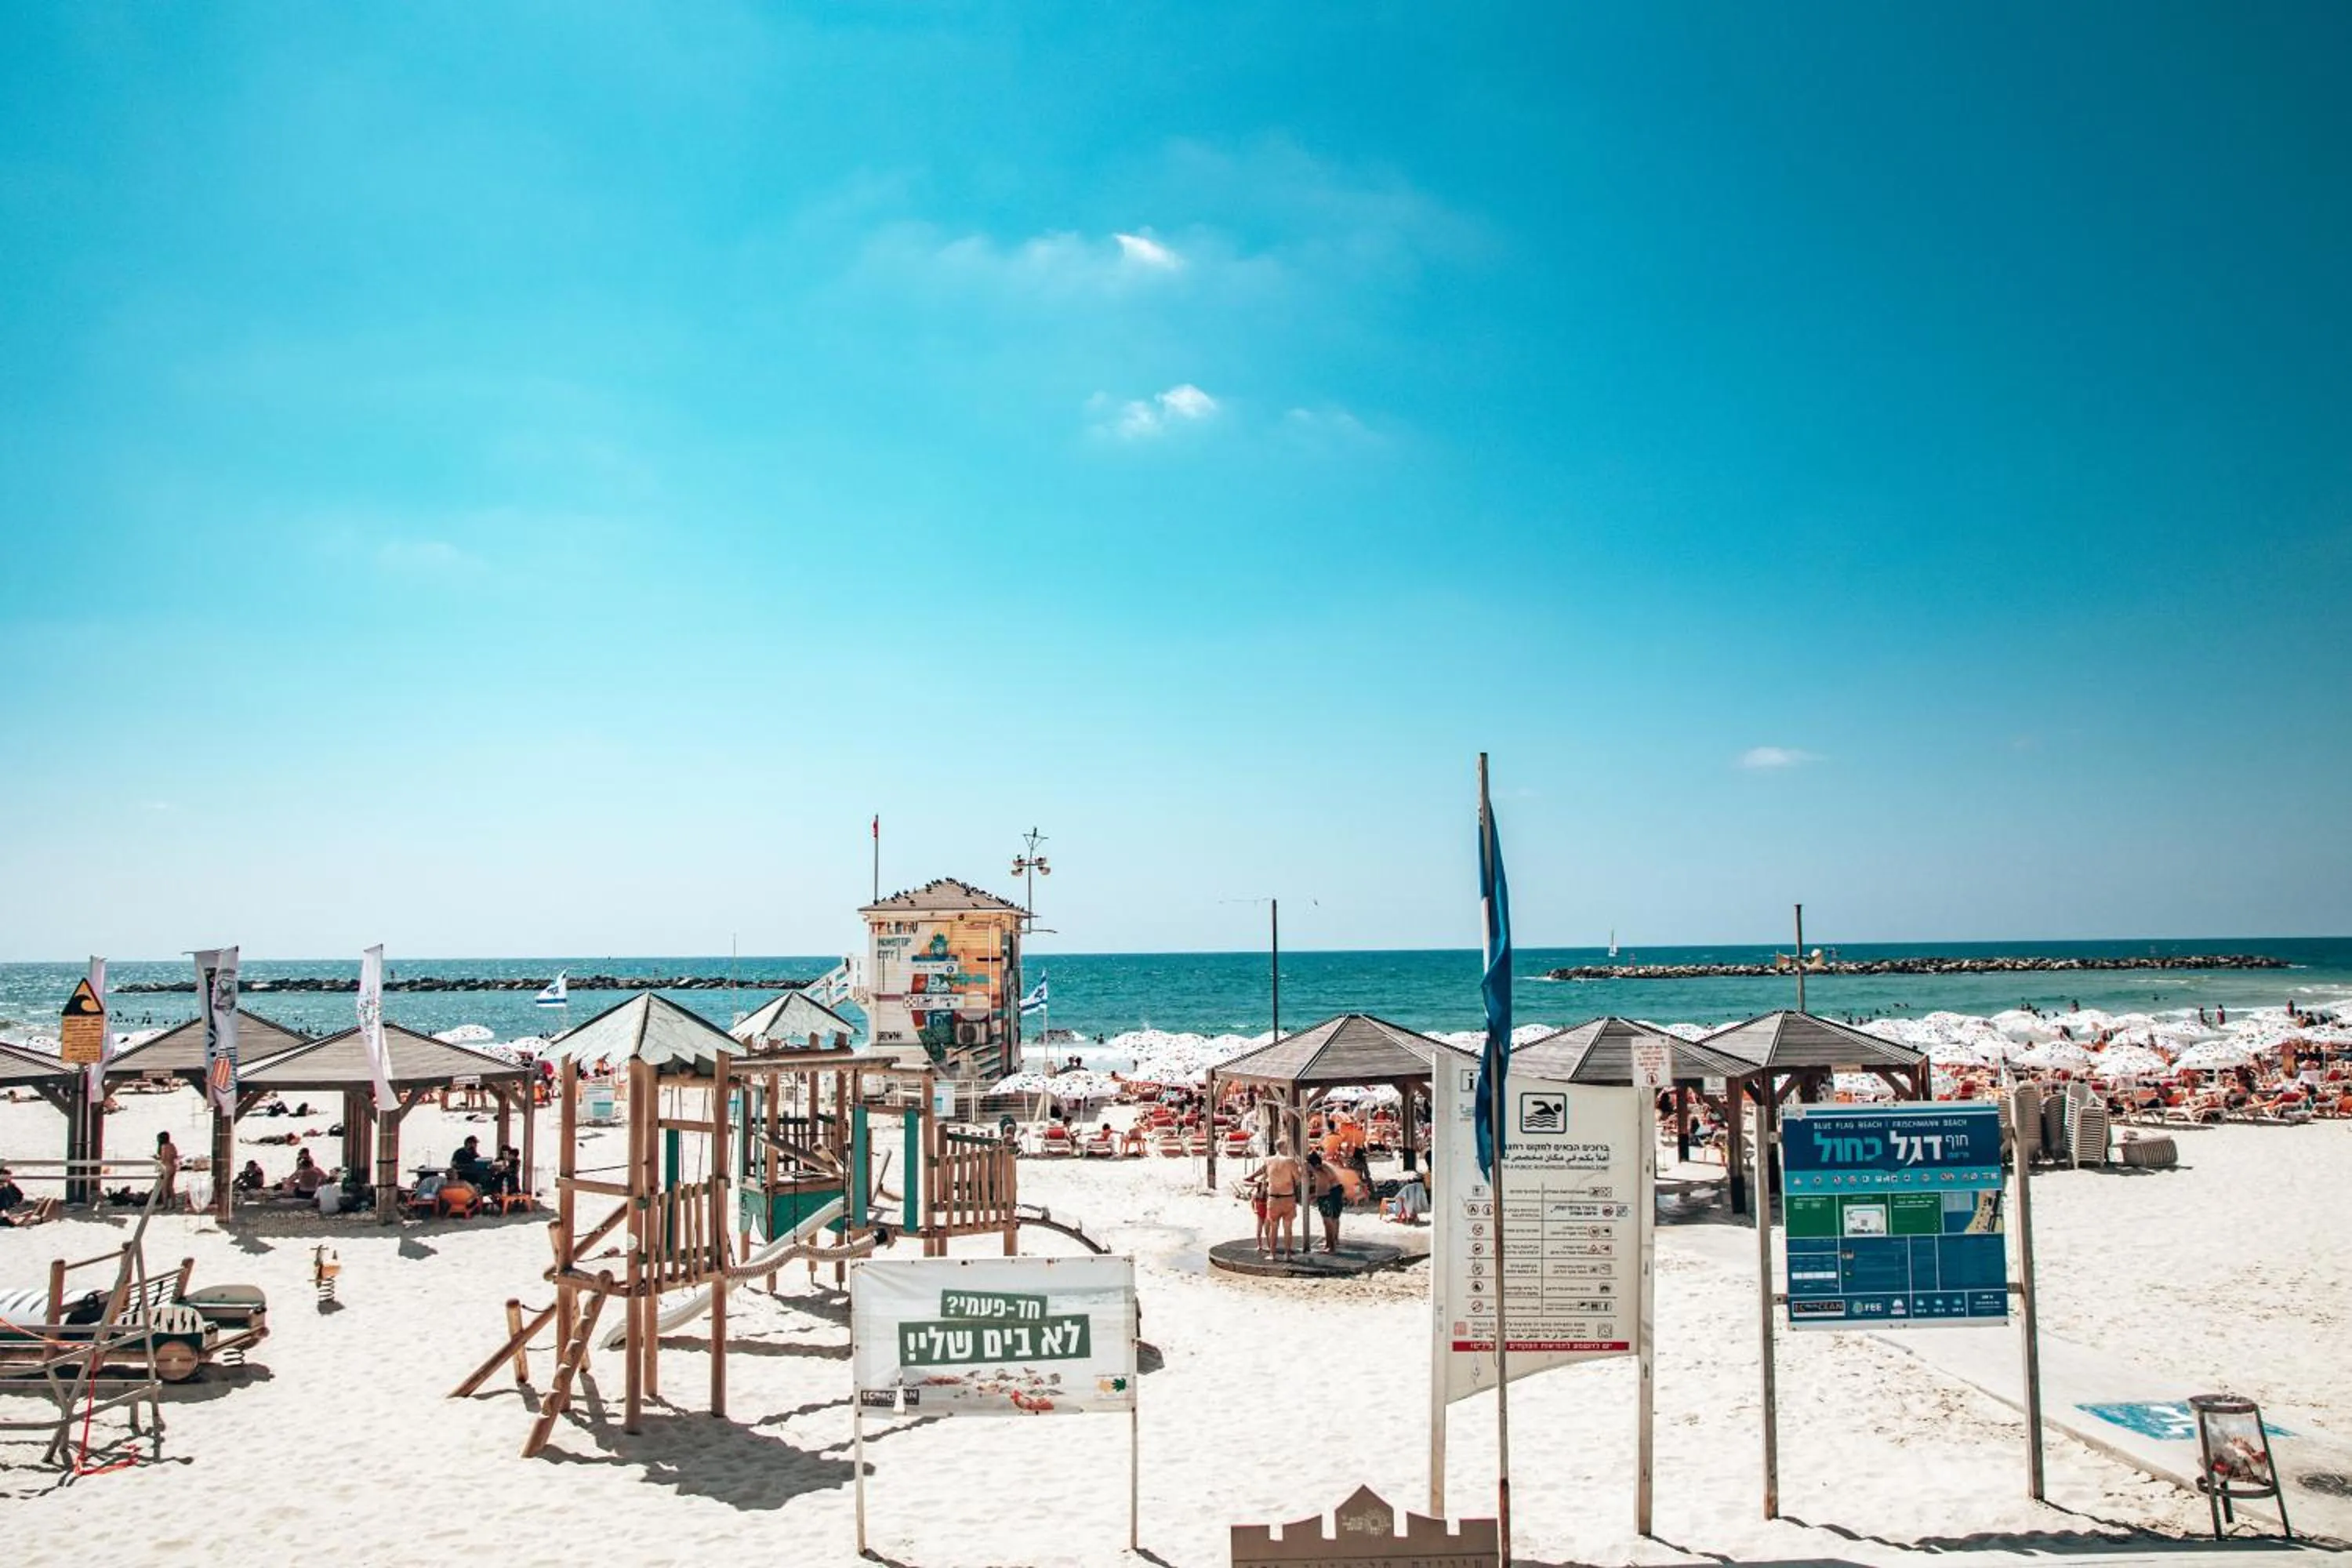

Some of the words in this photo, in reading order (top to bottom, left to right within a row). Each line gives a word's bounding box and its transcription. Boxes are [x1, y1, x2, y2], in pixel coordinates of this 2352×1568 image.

[1813, 1131, 1882, 1163] כחול
[1889, 1130, 1943, 1166] דגל
[1945, 1134, 1969, 1150] חוף
[946, 1295, 1040, 1319] חד-פעמי?
[906, 1325, 973, 1362] שלי!
[983, 1327, 1032, 1359] בים
[1040, 1319, 1081, 1356] לא
